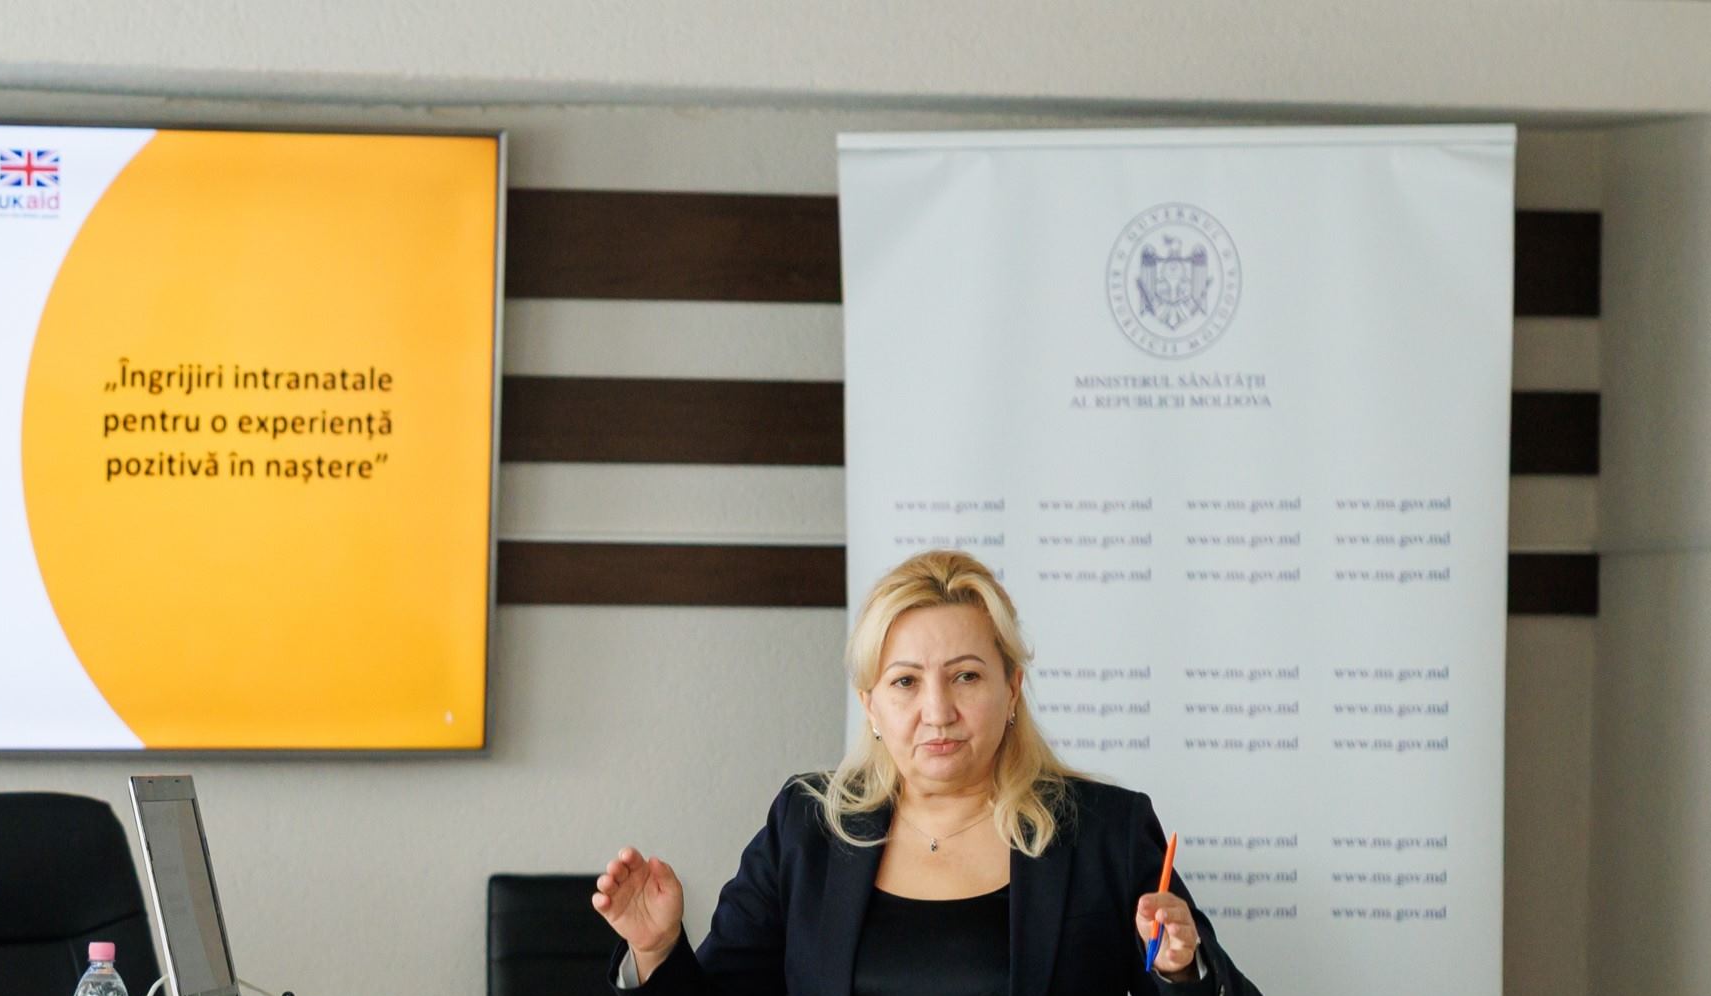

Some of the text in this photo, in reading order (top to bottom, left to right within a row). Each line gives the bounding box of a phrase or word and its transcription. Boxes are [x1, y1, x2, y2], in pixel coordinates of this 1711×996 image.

[234, 364, 393, 392] intranatale
[103, 409, 392, 441] pentru o experiență
[106, 451, 219, 482] pozitivă
[229, 452, 254, 477] în
